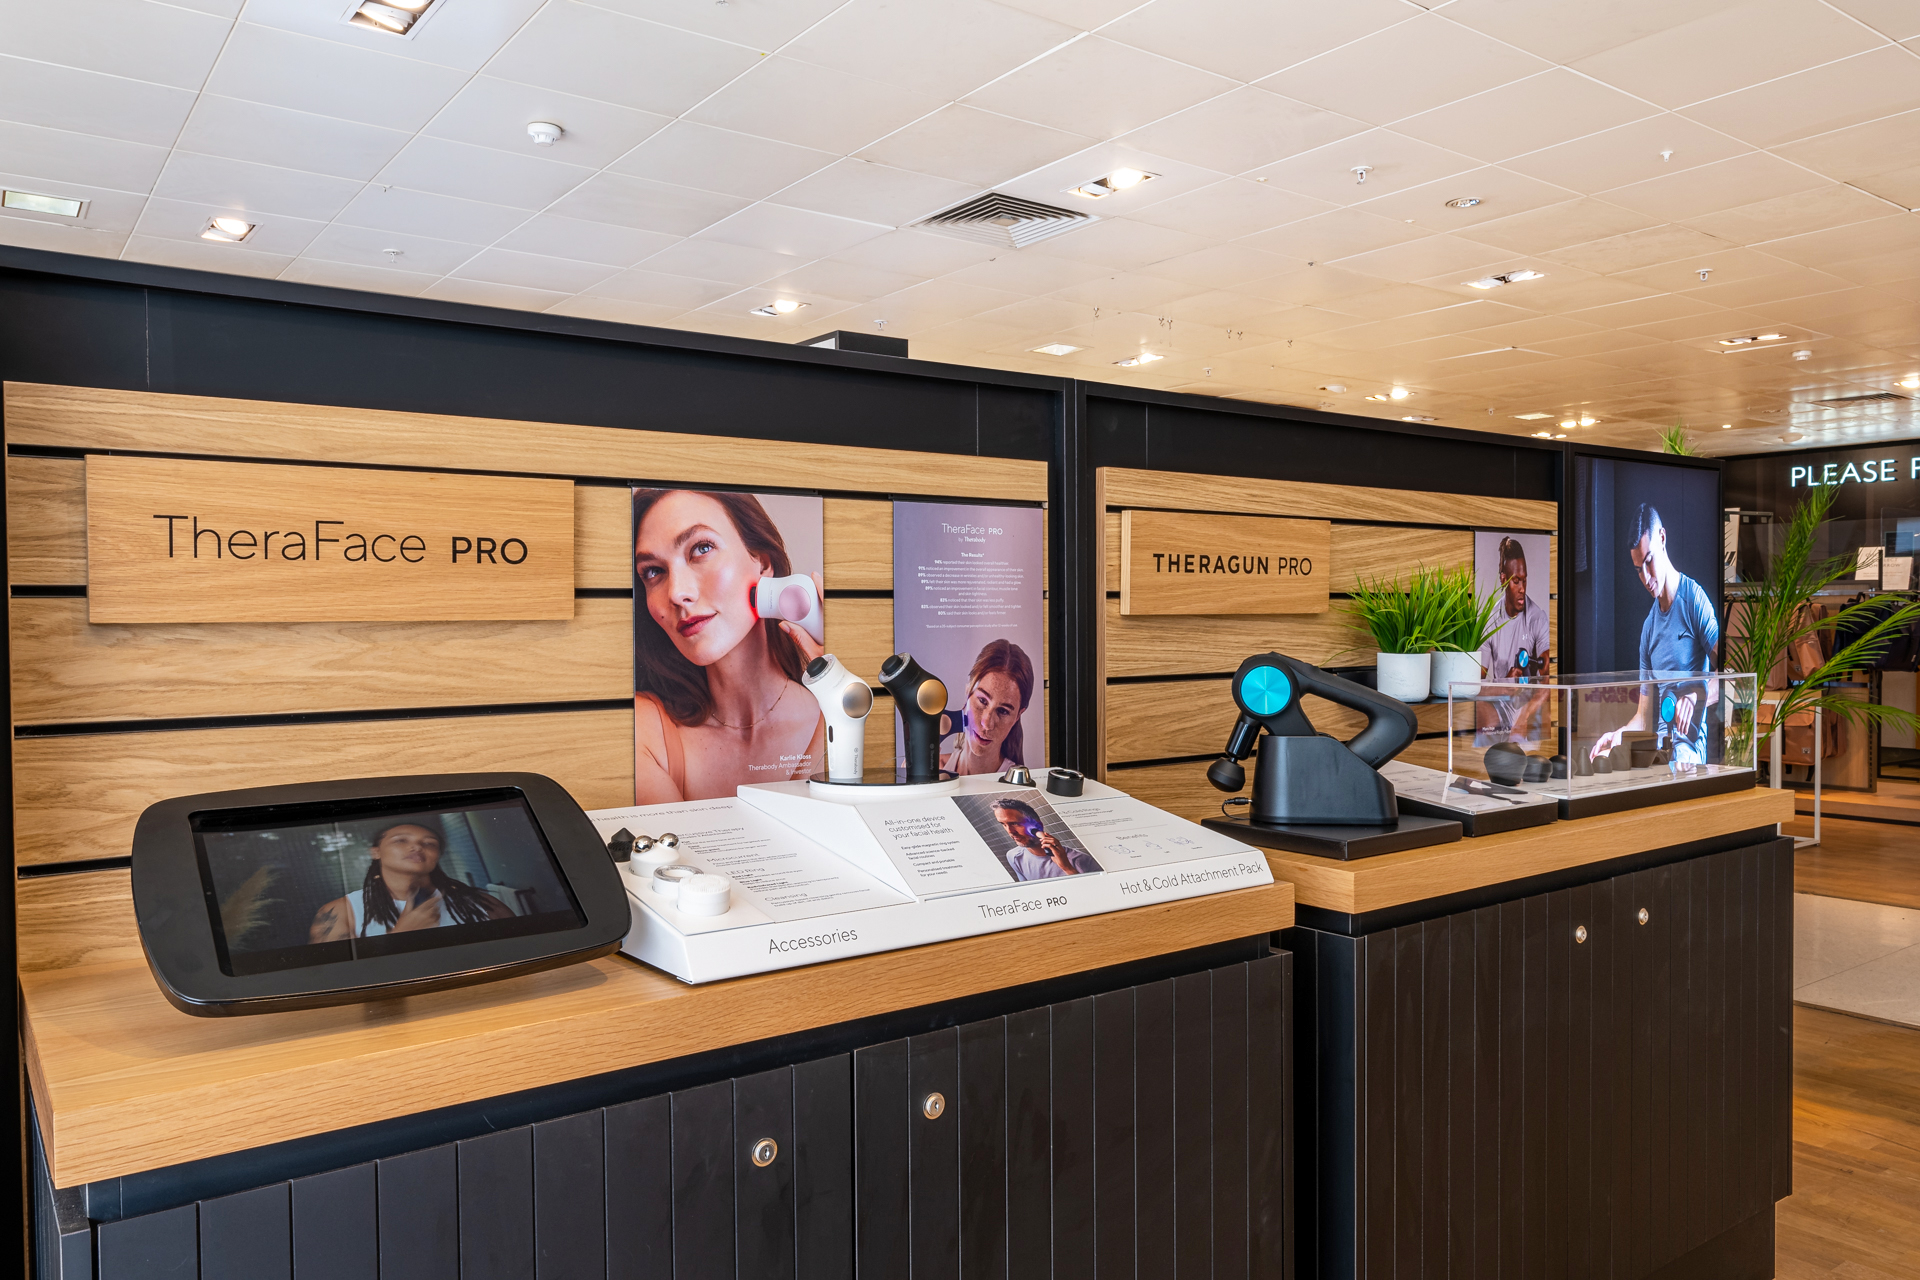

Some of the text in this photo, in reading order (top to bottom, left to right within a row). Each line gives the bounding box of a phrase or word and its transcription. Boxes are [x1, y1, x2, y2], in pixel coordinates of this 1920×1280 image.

[1791, 459, 1896, 487] PLEASE
[153, 514, 528, 565] TheraFace PRO
[942, 523, 985, 534] TheraFace
[1153, 554, 1312, 576] THERAGUN PRO
[889, 823, 930, 832] customised
[1120, 861, 1263, 895] Hot & Cold Attachment Pack
[978, 896, 1067, 919] TheraFace PRO
[768, 928, 858, 954] Accessories
